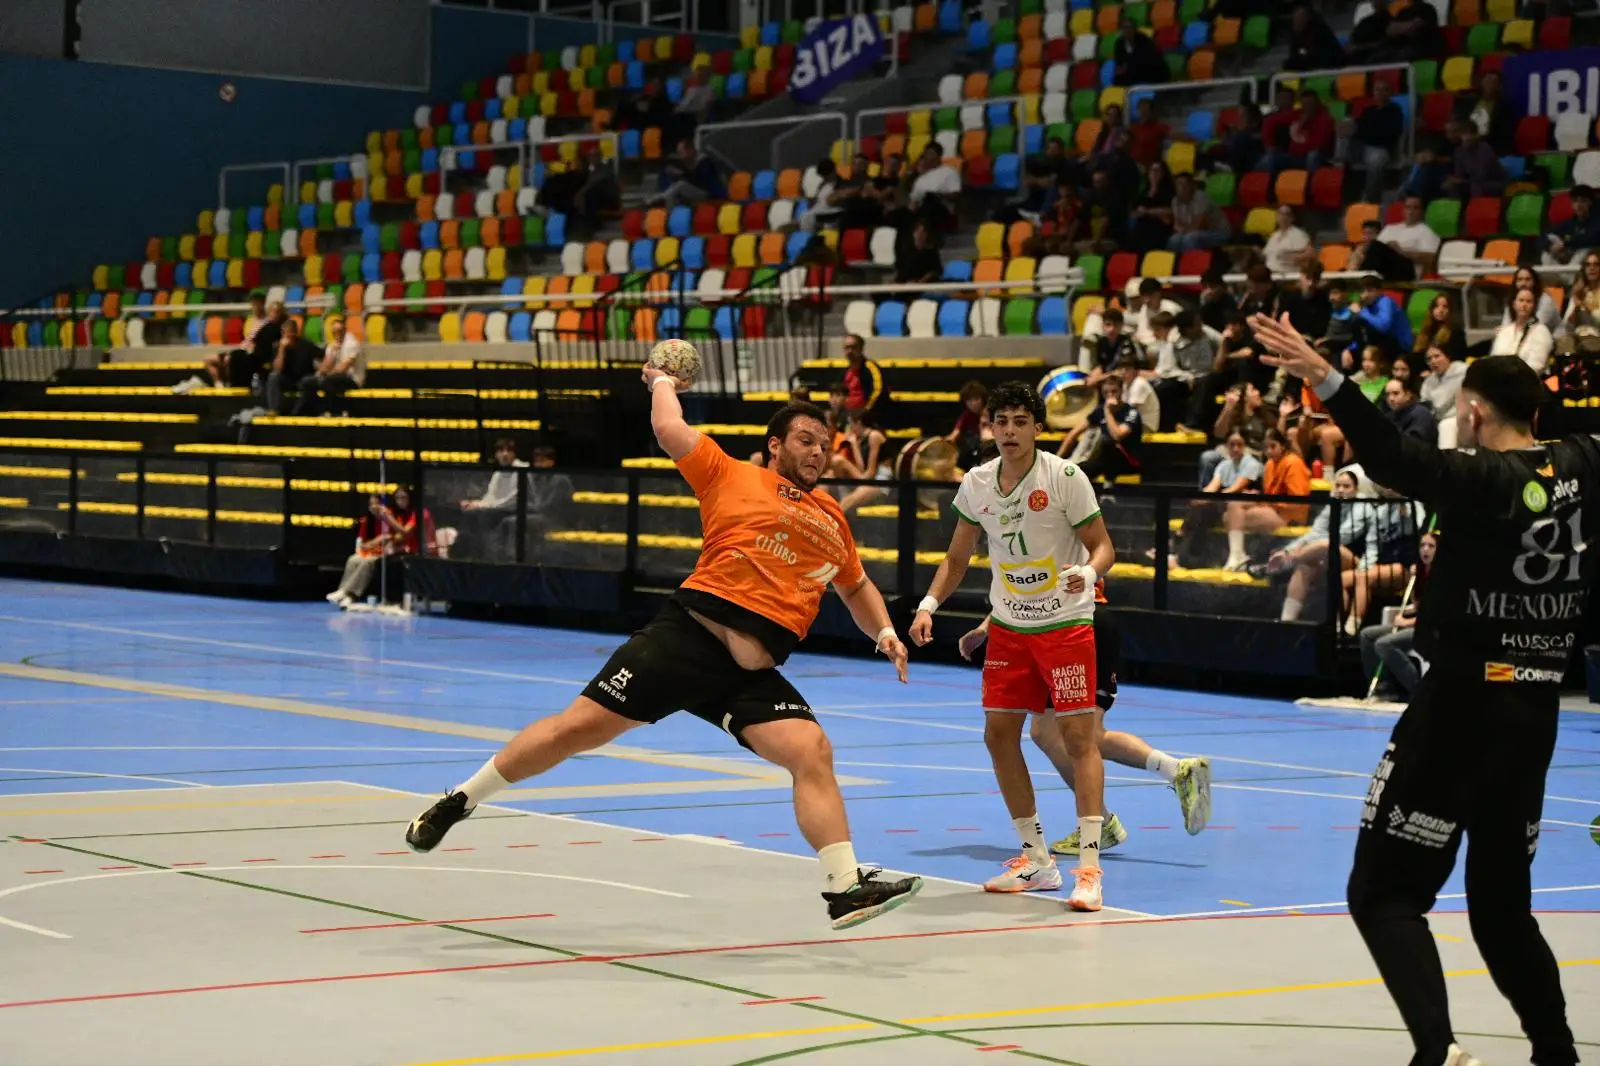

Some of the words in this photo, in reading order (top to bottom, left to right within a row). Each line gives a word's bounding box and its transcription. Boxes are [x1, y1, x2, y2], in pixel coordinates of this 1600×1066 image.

[1001, 530, 1028, 556] 71
[1512, 507, 1587, 585] 81
[1005, 571, 1049, 585] Bada
[598, 680, 627, 703] eivissa
[1054, 676, 1087, 691] SABOR
[1063, 689, 1088, 699] VERDAD
